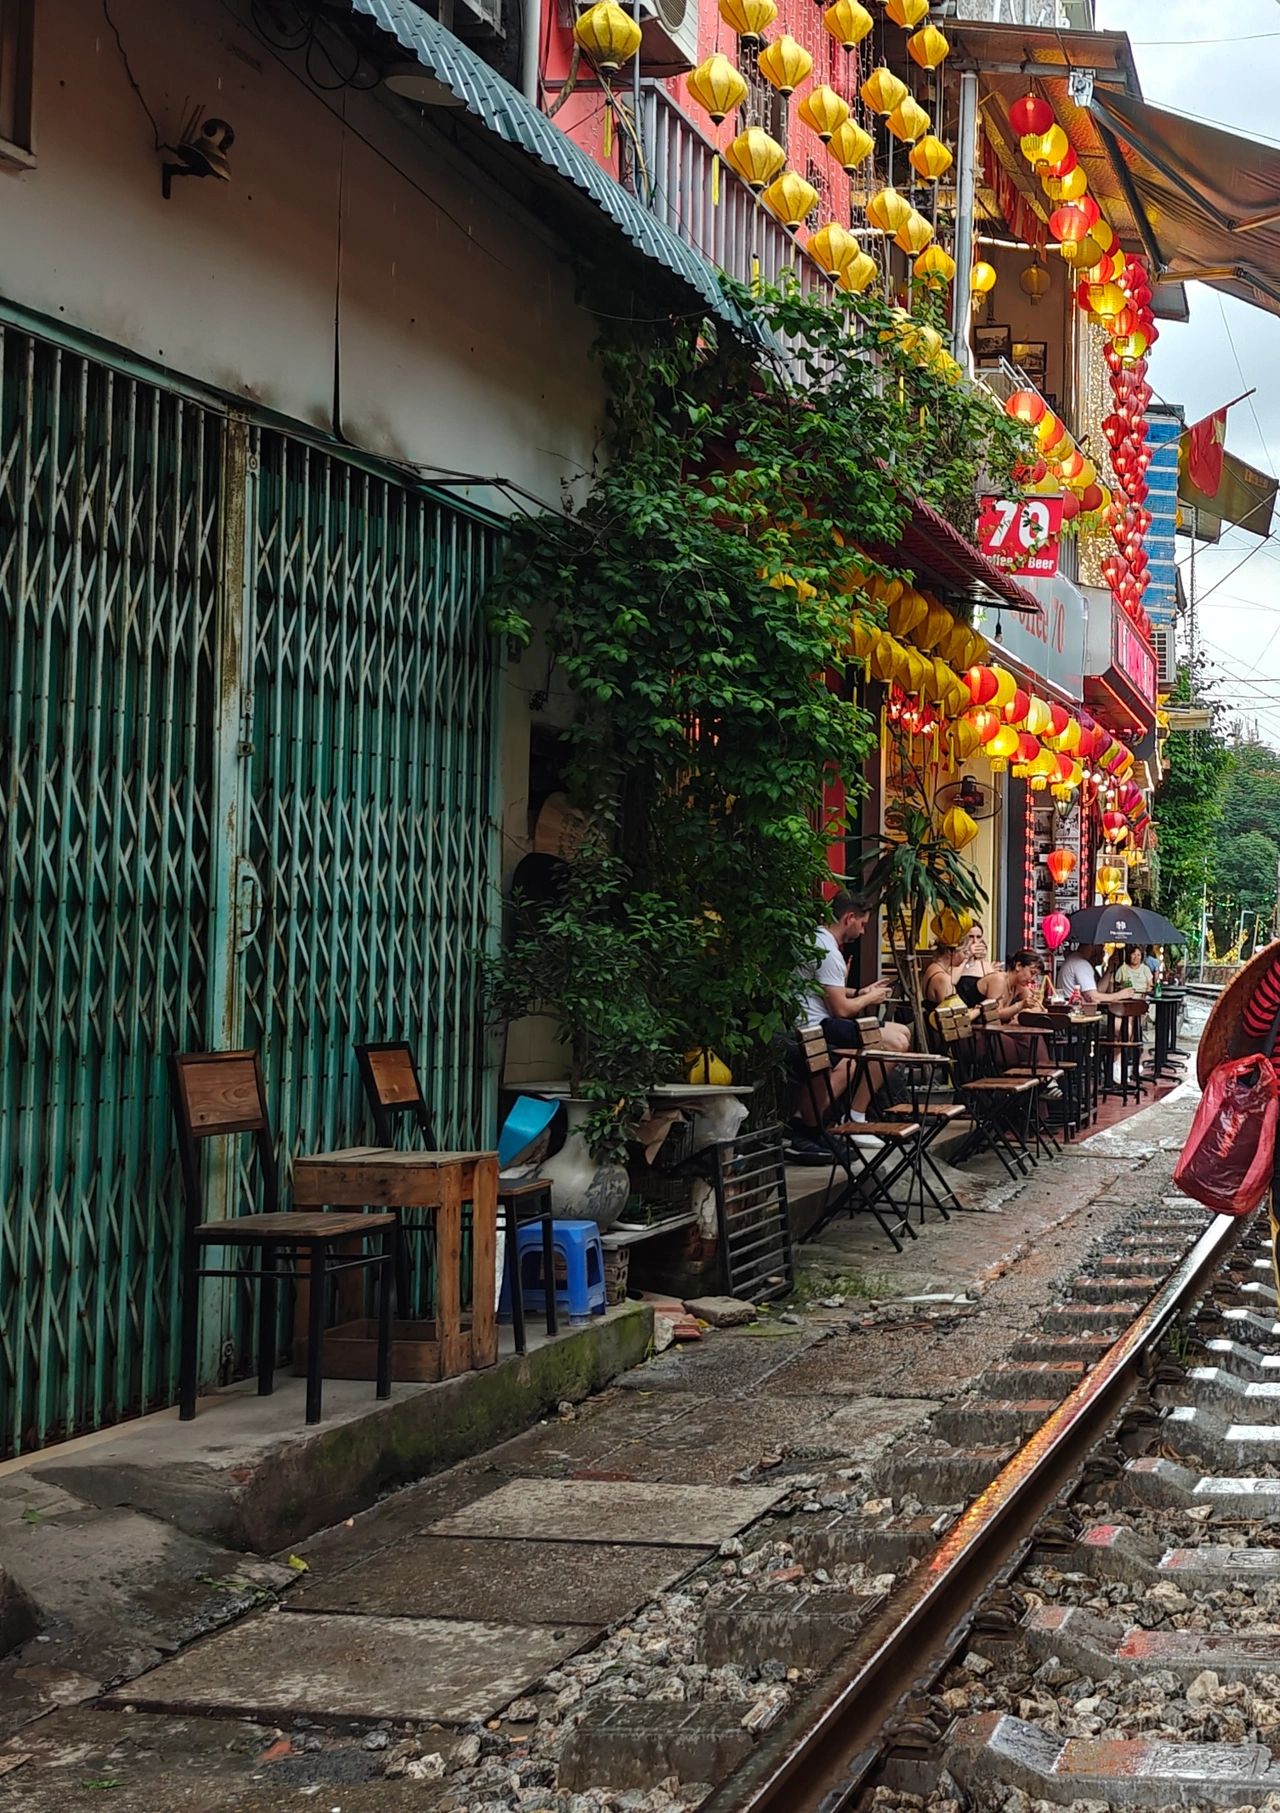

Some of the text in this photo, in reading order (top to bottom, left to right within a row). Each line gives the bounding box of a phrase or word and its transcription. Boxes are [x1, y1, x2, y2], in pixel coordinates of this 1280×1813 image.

[988, 500, 1051, 549] 70
[1028, 557, 1054, 570] Beer
[1051, 597, 1065, 653] 70
